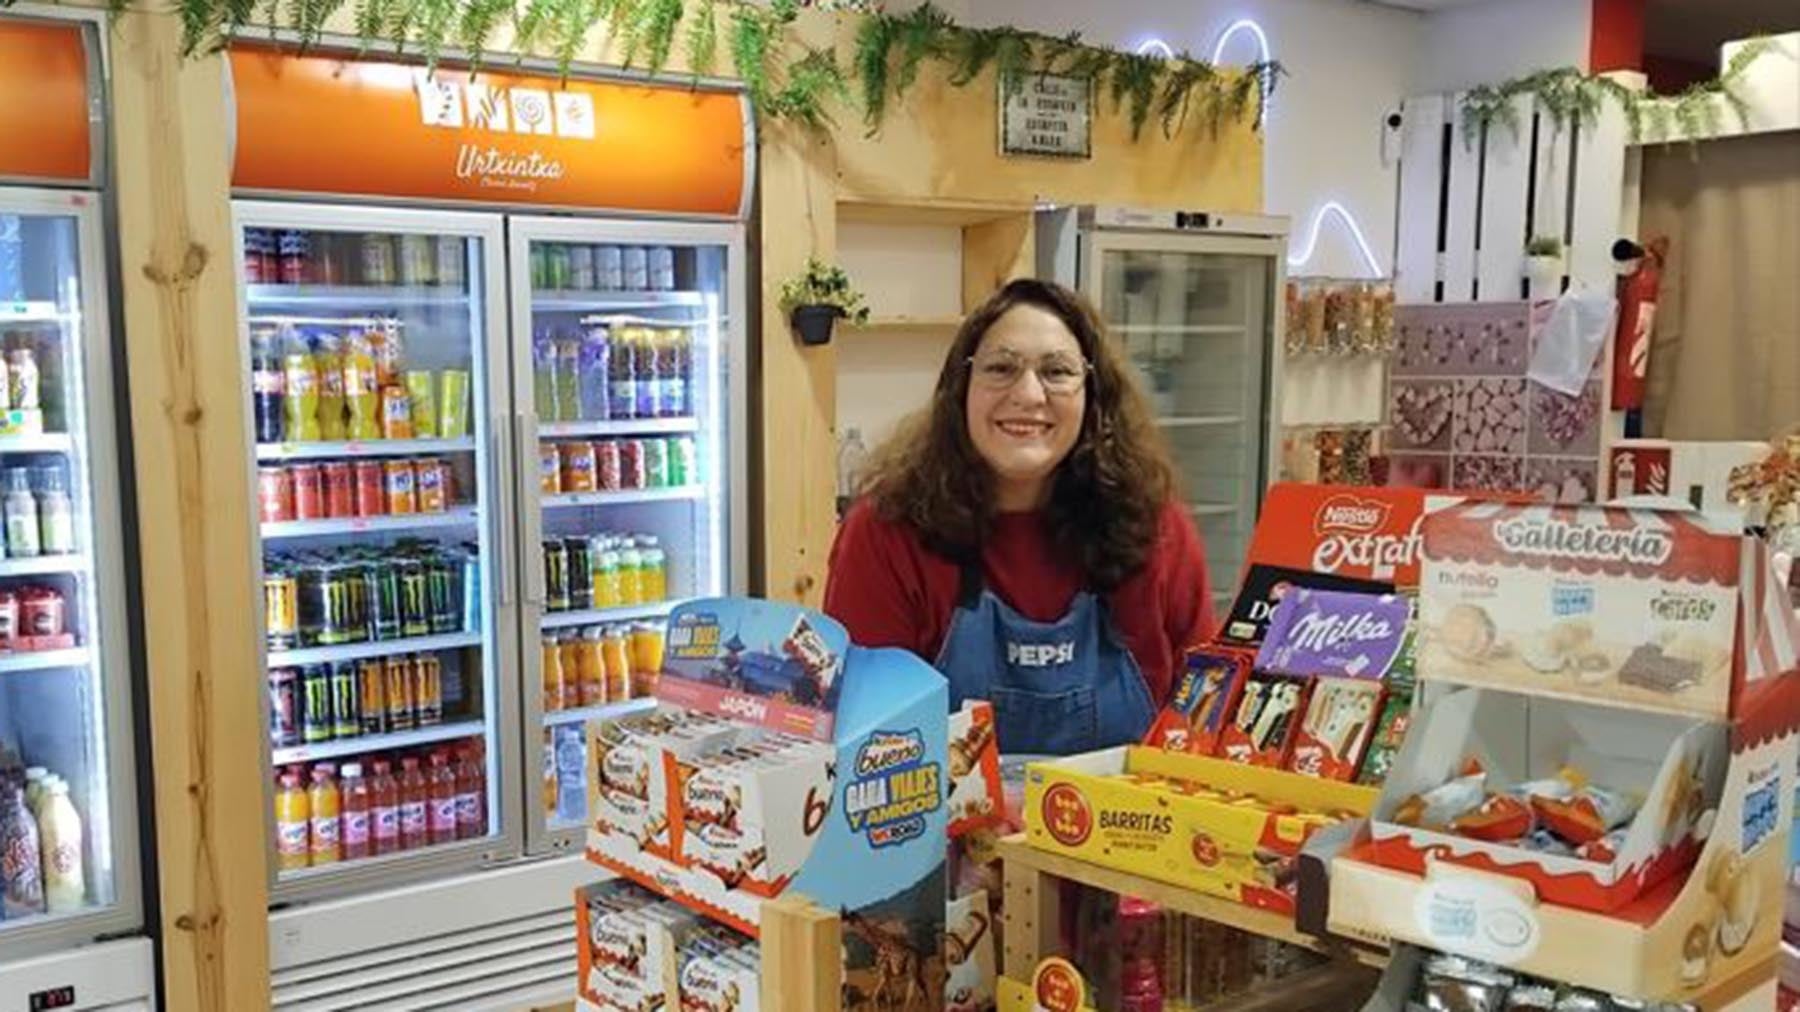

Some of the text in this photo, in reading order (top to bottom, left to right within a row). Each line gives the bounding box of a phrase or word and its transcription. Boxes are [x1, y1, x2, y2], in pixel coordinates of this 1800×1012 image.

[457, 144, 563, 177] Urtxintxa
[1288, 611, 1393, 652] Milka
[1008, 641, 1075, 666] PEPSI
[858, 745, 921, 773] bueno
[1100, 809, 1173, 834] BARRITAS
